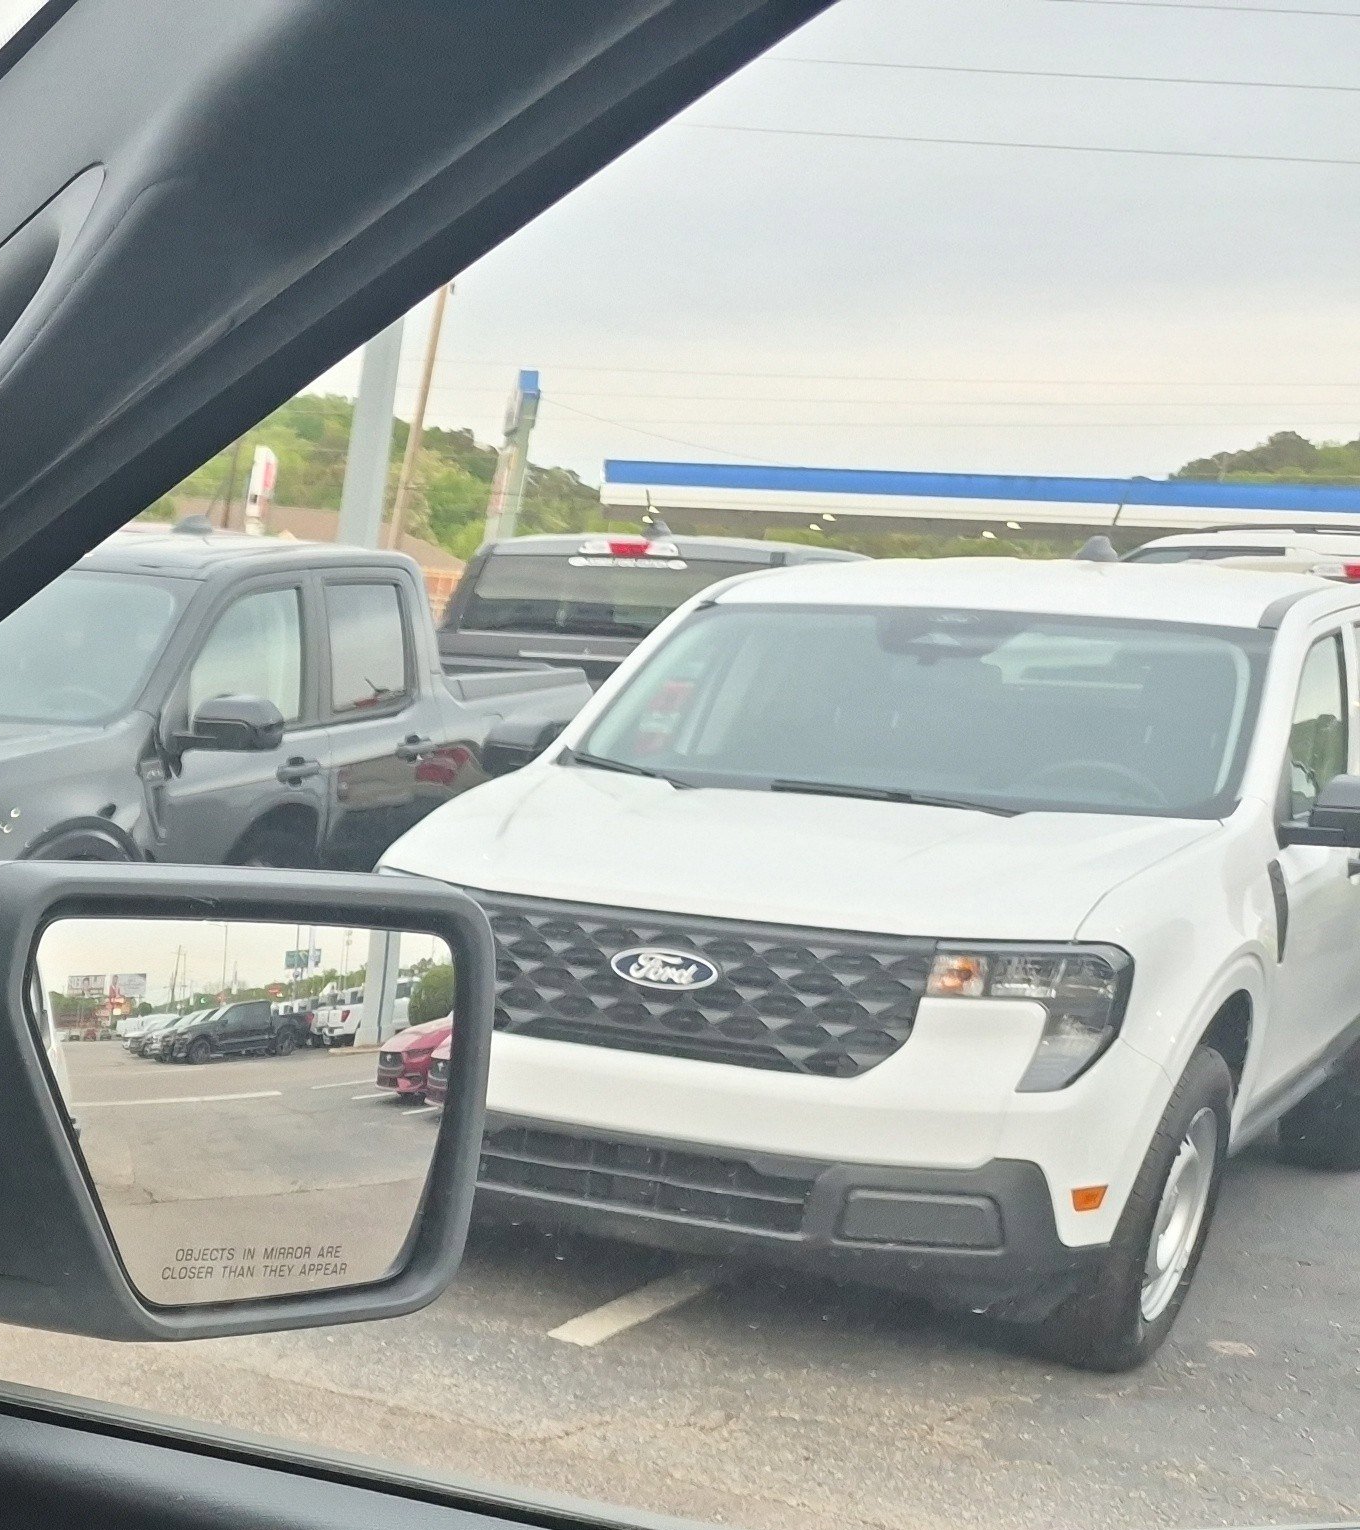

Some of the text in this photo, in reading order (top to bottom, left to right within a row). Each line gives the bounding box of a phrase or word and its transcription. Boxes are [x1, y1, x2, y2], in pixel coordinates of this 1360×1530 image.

[629, 952, 699, 985] Ford
[174, 1245, 342, 1262] OBJECTS IN MIRROR ARE
[161, 1262, 348, 1280] CLOSER THAN THEY APPEAR
